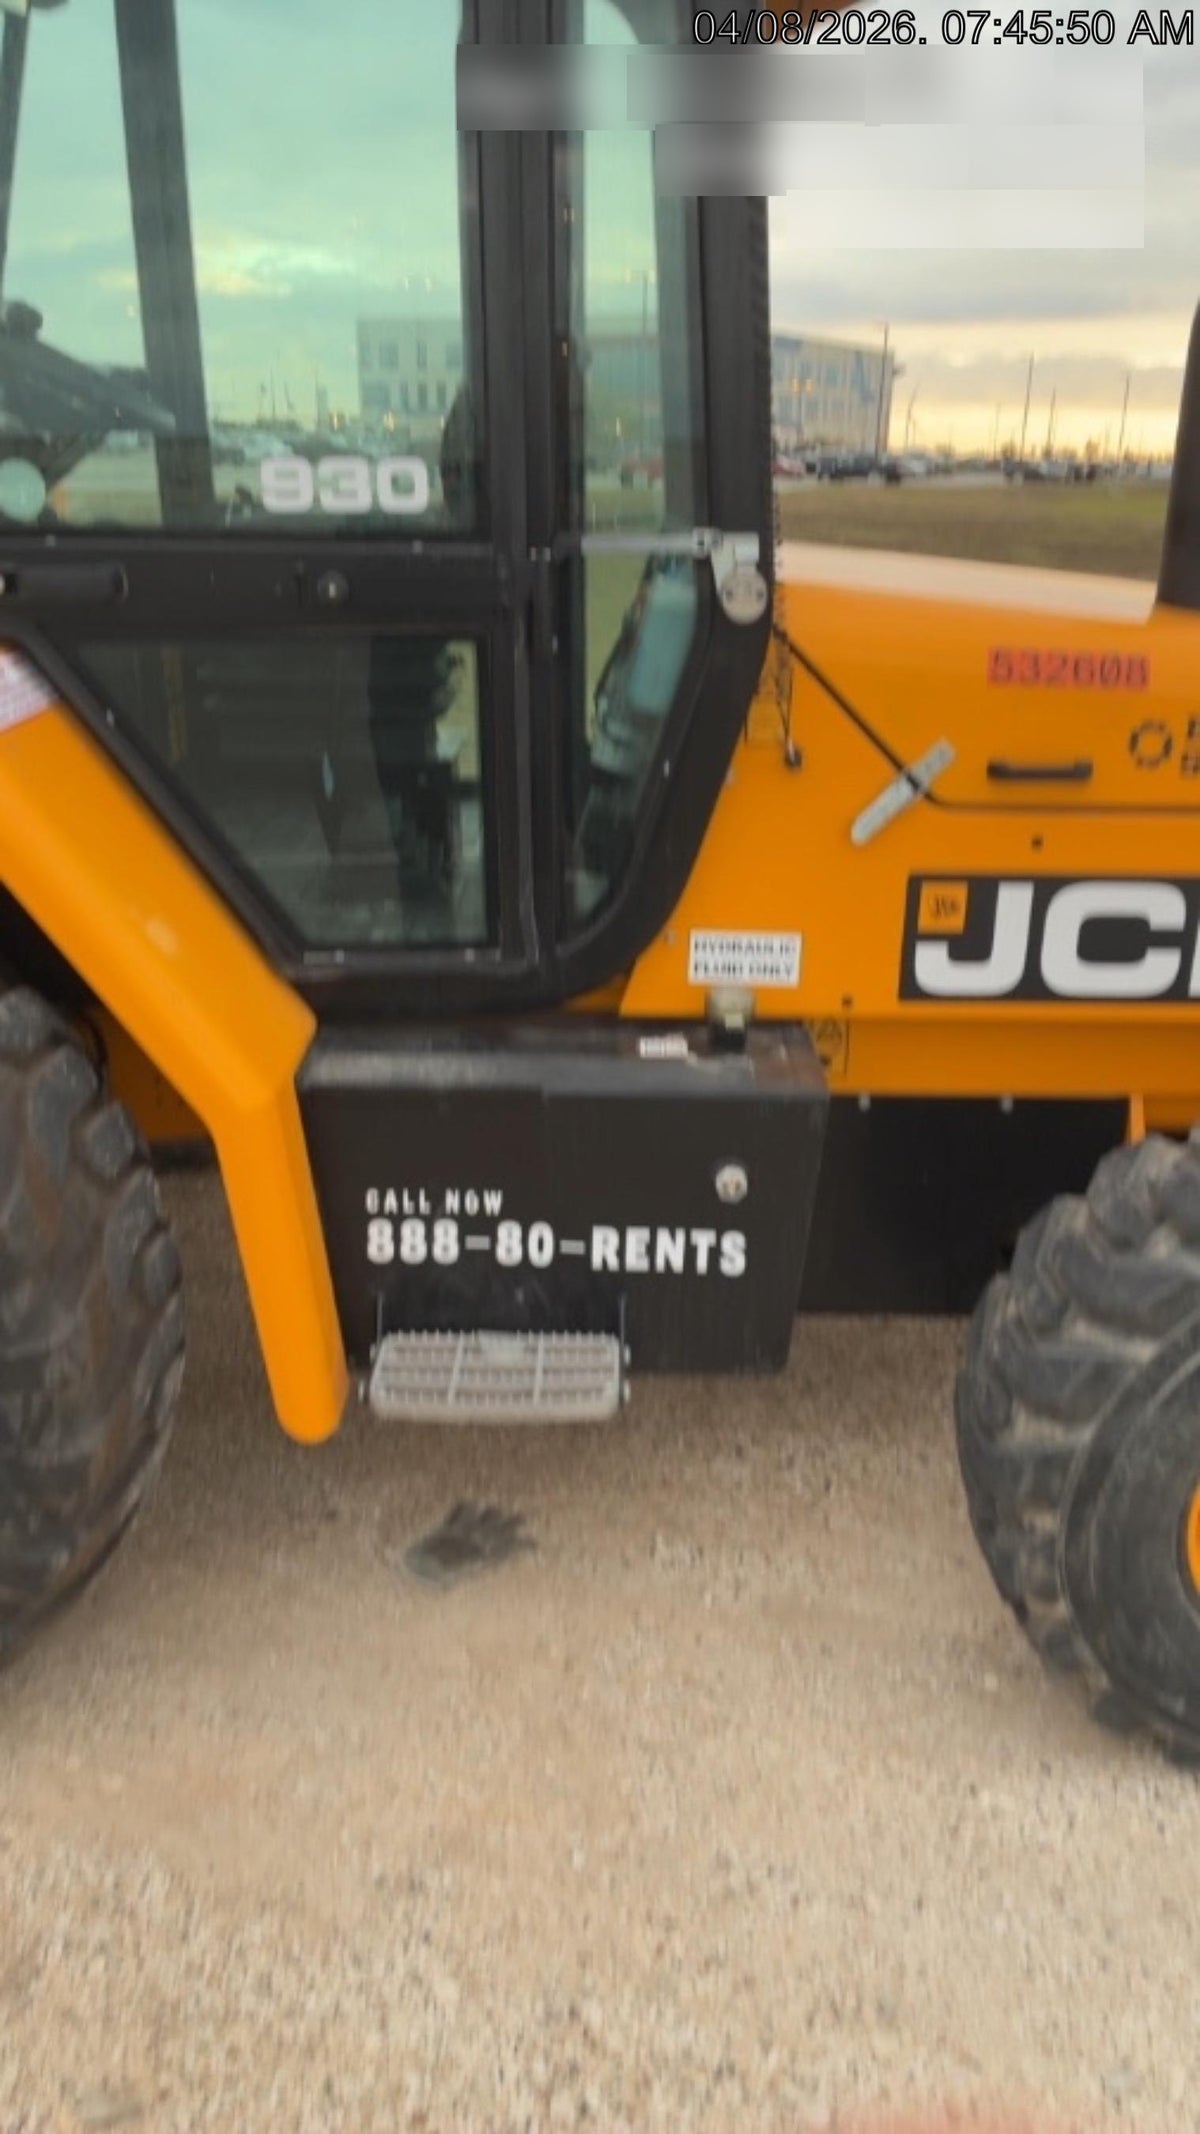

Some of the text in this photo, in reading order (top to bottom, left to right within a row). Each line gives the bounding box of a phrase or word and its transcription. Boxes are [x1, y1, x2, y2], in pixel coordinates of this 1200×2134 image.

[260, 455, 429, 514] 930
[991, 648, 1149, 688] 532608
[693, 938, 797, 956] HYDRAULIC
[914, 880, 1200, 998] JC
[693, 960, 794, 979] FLUID ONLY
[366, 1187, 503, 1217] CALL NOW
[366, 1217, 747, 1278] 888-80-RENTS
